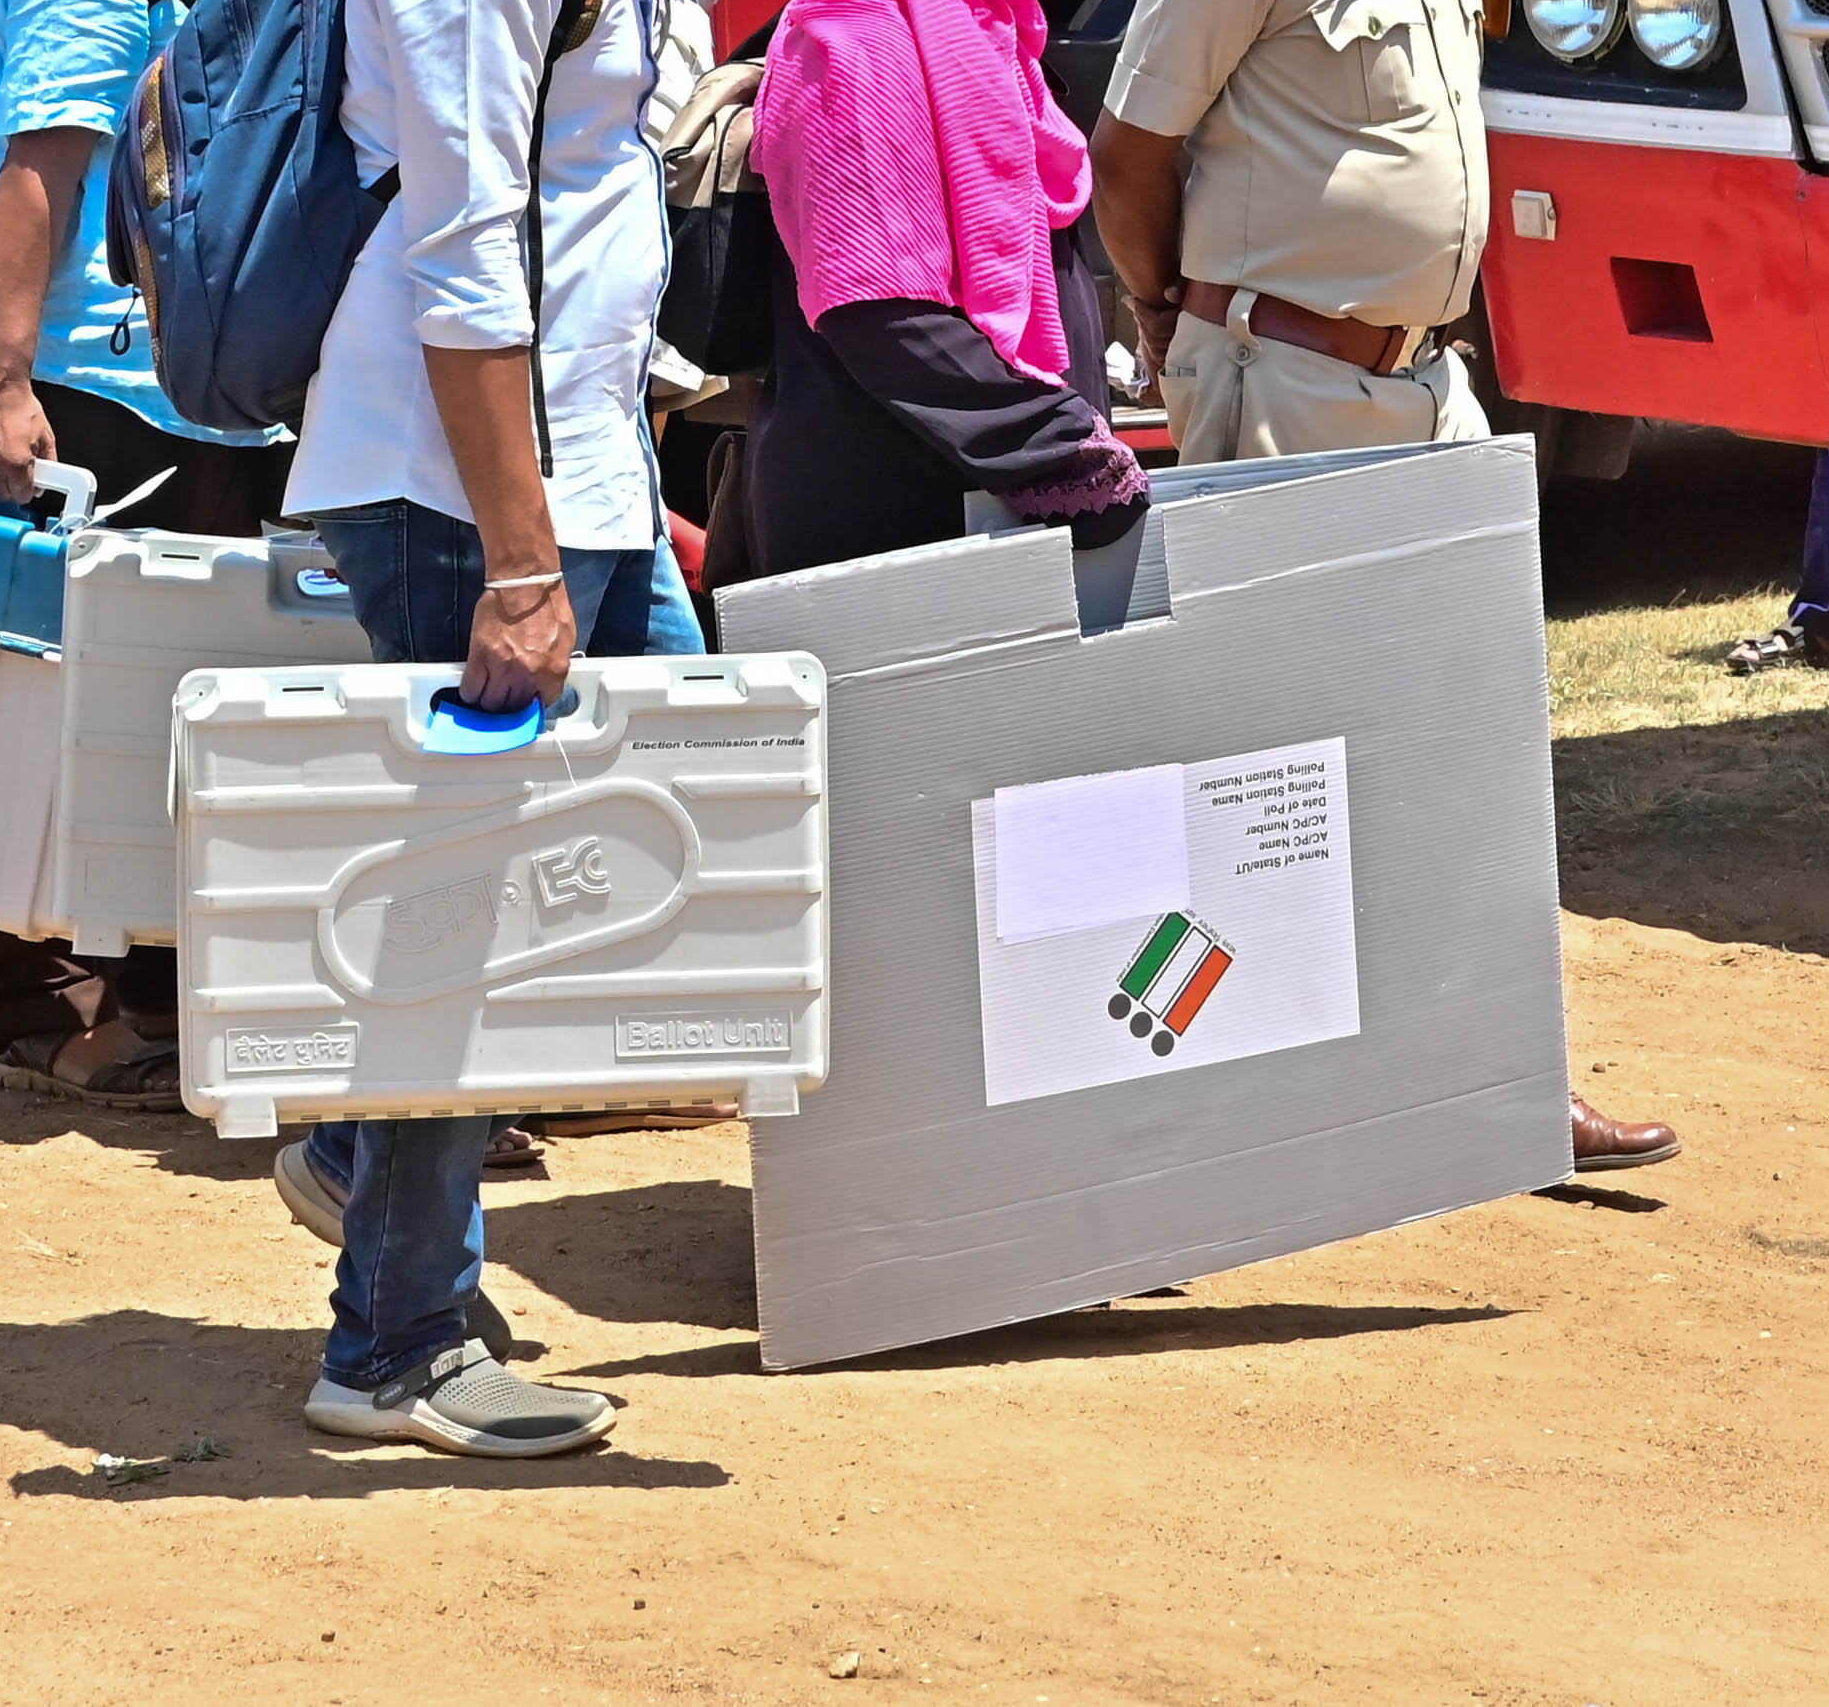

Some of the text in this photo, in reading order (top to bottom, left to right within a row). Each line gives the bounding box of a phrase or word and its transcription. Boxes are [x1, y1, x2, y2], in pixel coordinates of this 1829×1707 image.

[631, 737, 806, 750] Election Commission of India
[1198, 761, 1325, 792] Polling Station Number
[1211, 778, 1326, 806] Polling Station Name
[1263, 796, 1327, 817] Date of Poll
[1245, 812, 1328, 836] AC/PC Number
[1258, 830, 1329, 851] AC/PC Name
[1235, 848, 1330, 875] Name of State/UT
[627, 1017, 785, 1050] Ballot Unit
[235, 1034, 288, 1063] बैलेट
